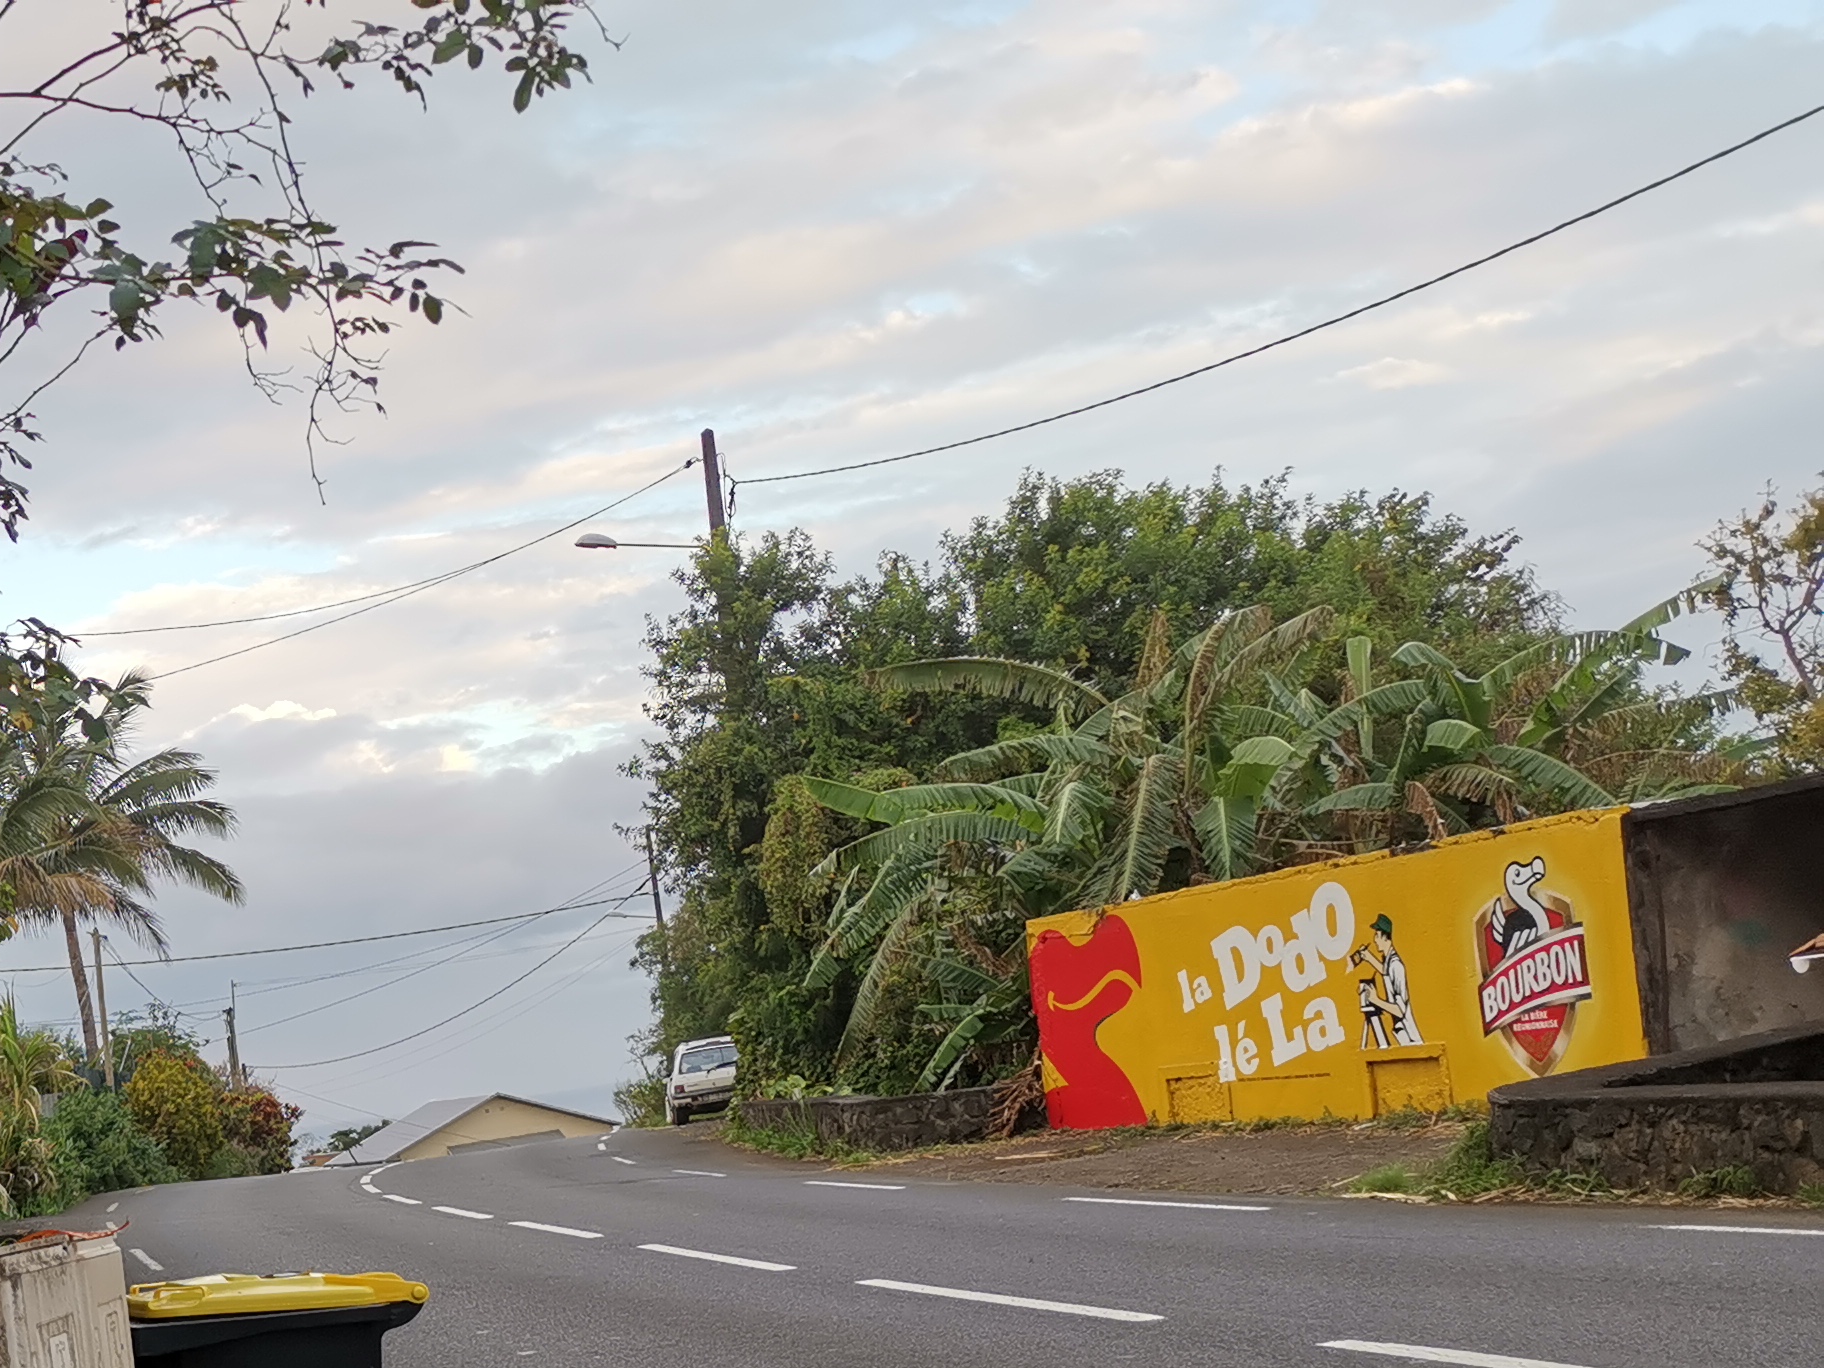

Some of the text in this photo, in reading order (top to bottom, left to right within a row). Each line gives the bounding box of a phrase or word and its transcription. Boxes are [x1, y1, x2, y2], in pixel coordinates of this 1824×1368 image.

[1177, 969, 1213, 1014] la
[1482, 939, 1583, 1024] BOURBON
[1213, 992, 1346, 1084] lé La
